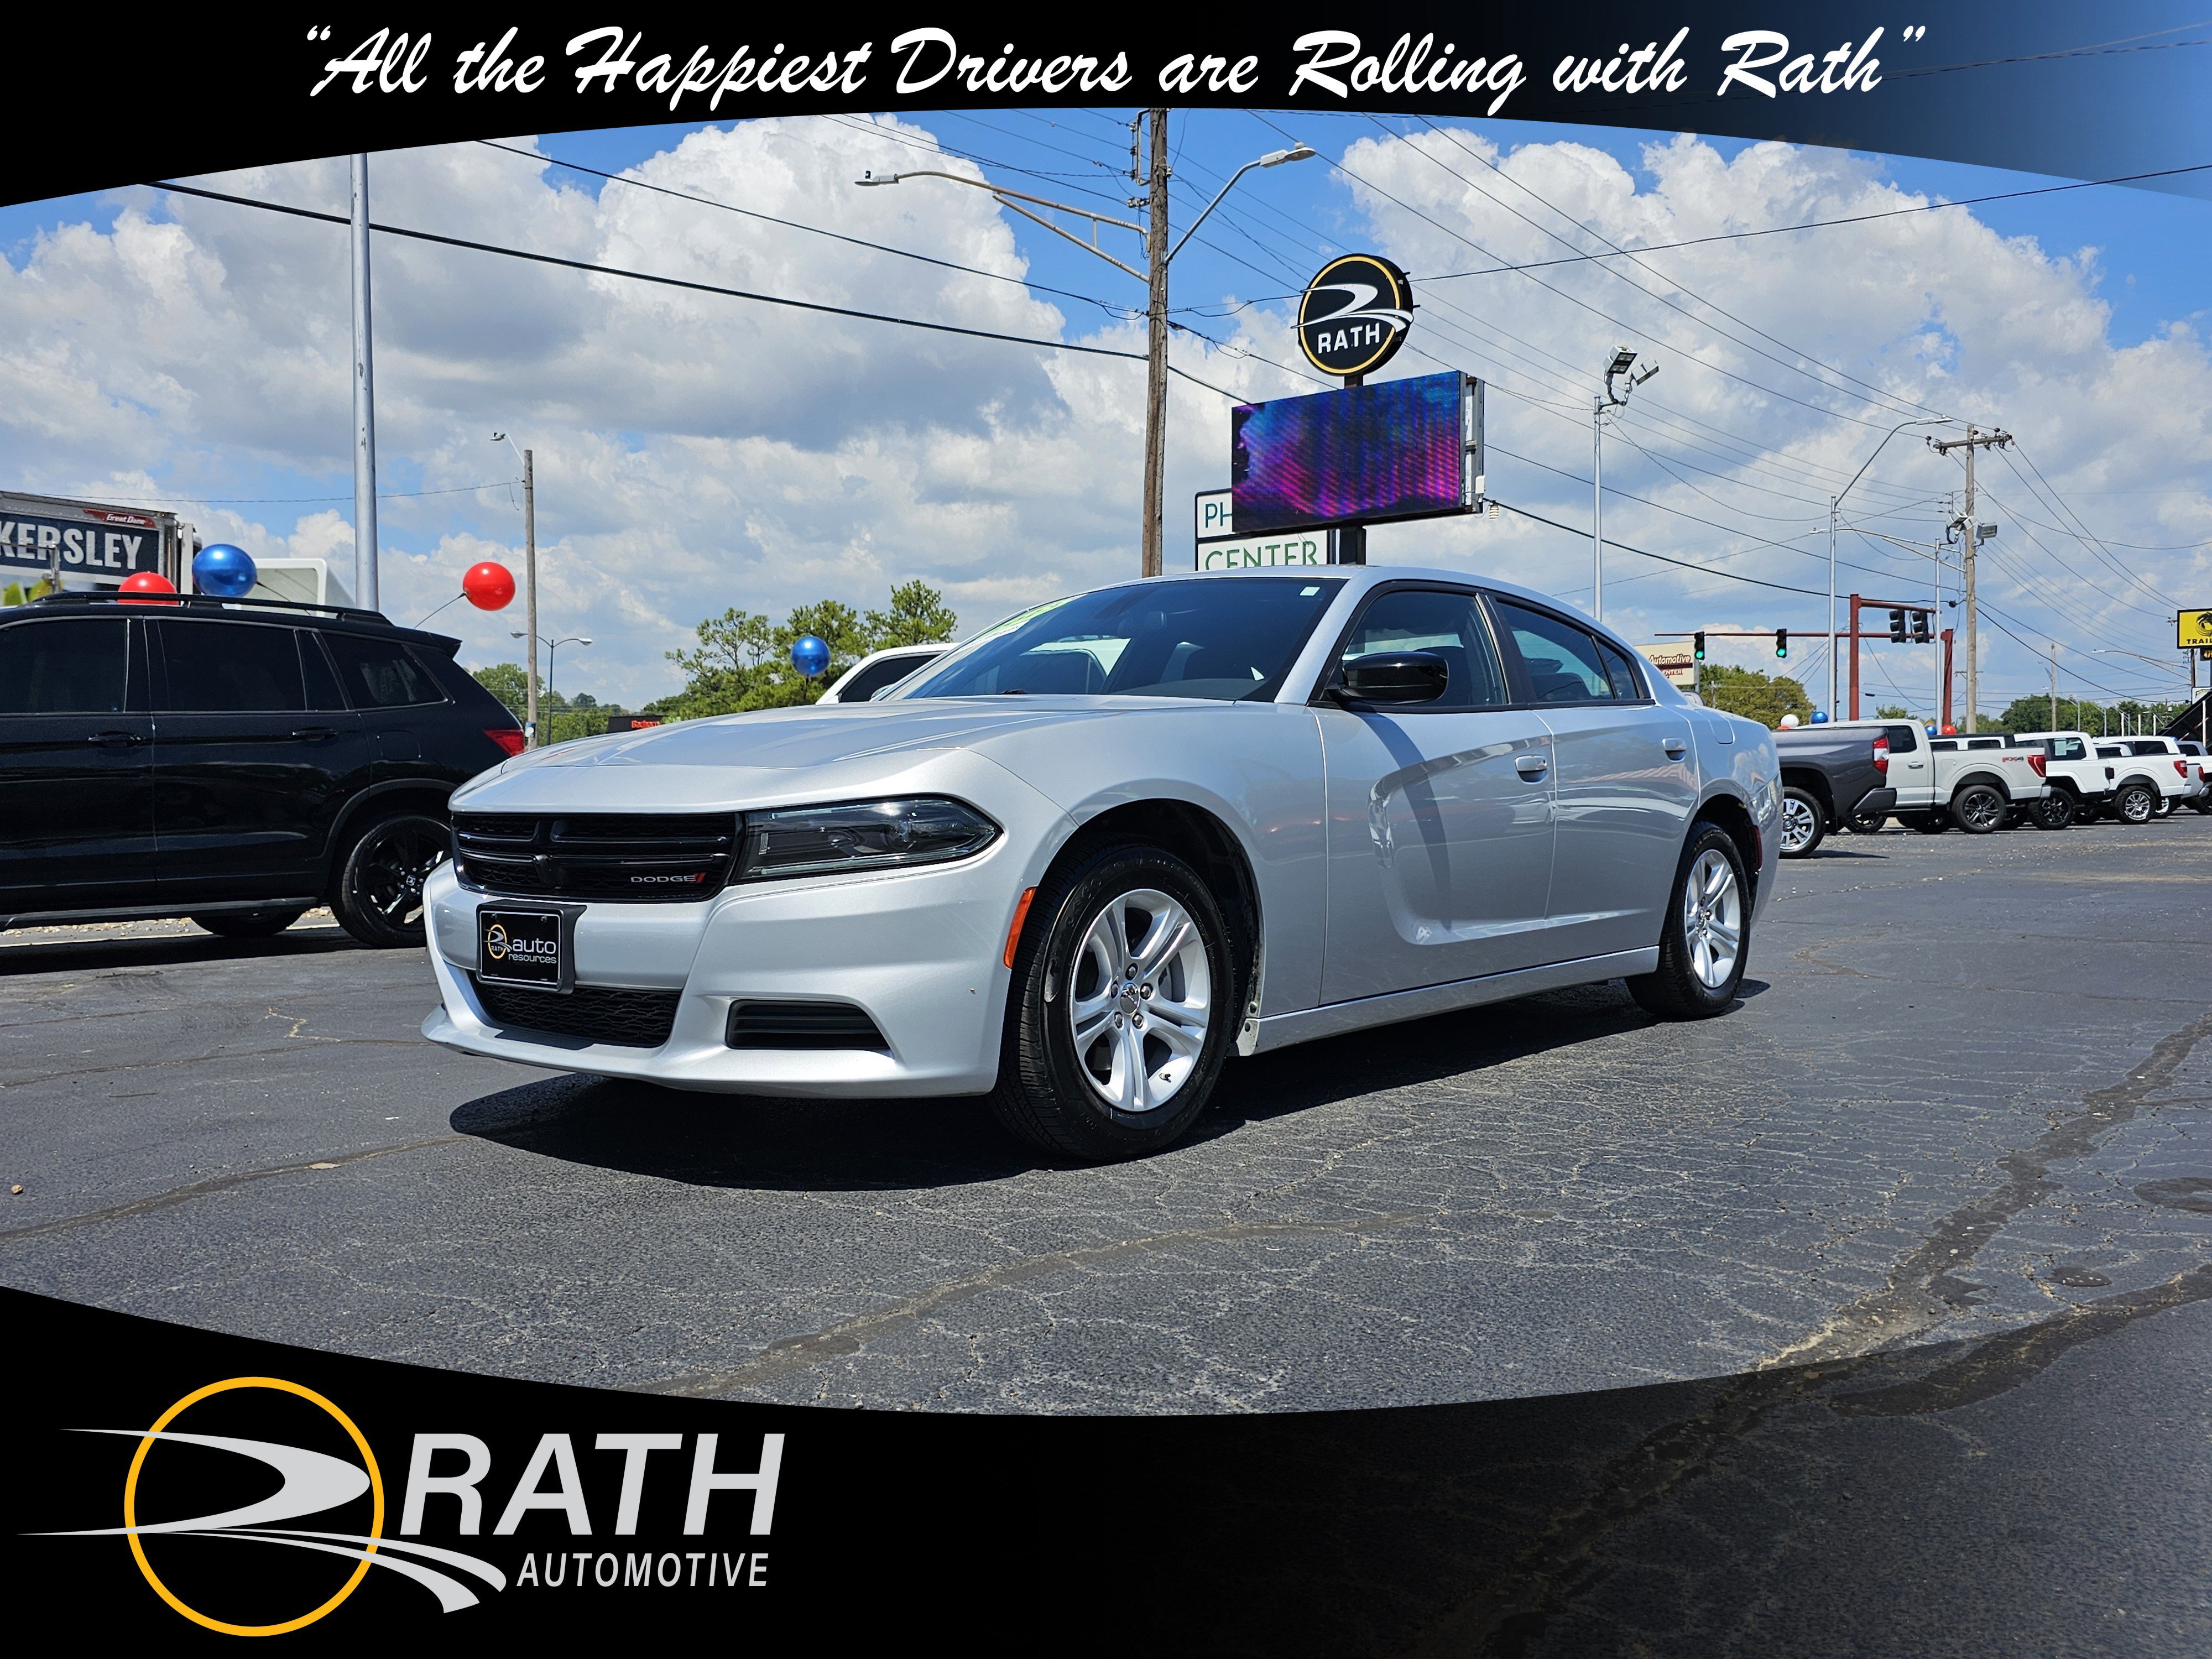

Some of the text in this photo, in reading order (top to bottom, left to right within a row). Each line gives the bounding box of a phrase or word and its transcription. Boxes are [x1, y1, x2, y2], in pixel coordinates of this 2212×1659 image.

[1318, 322, 1380, 354] RATH
[1205, 540, 1317, 570] CENTER
[1649, 654, 1691, 665] Automotive
[512, 938, 556, 954] auto
[508, 953, 557, 964] resources
